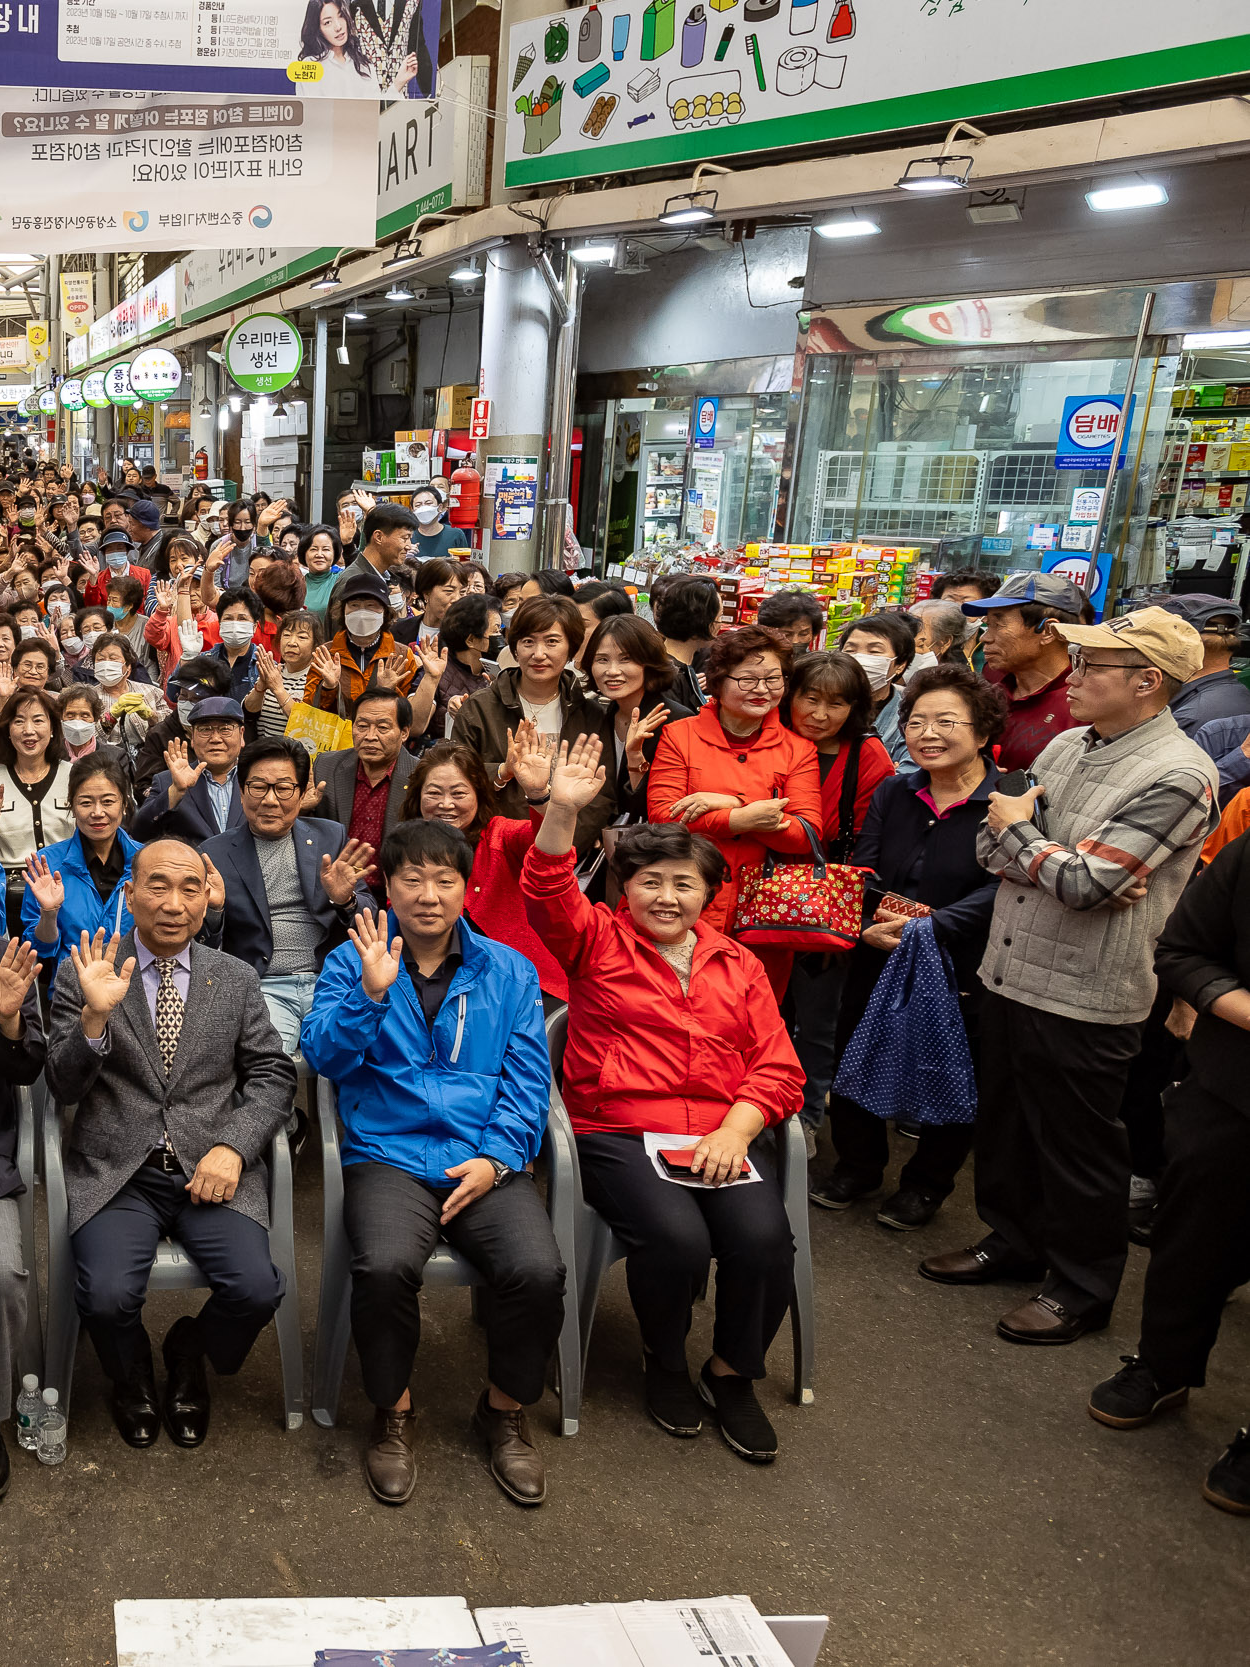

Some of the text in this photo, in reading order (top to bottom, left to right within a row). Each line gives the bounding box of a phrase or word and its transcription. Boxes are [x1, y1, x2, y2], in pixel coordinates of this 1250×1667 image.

[199, 1, 225, 11] 경품안내
[18, 4, 40, 33] 내
[294, 71, 316, 80] 노현지
[378, 101, 440, 196] ART
[235, 331, 292, 350] 우리마트
[250, 351, 278, 369] 생선
[255, 376, 273, 387] 생선
[701, 410, 714, 423] 담배
[1075, 413, 1121, 434] 담배
